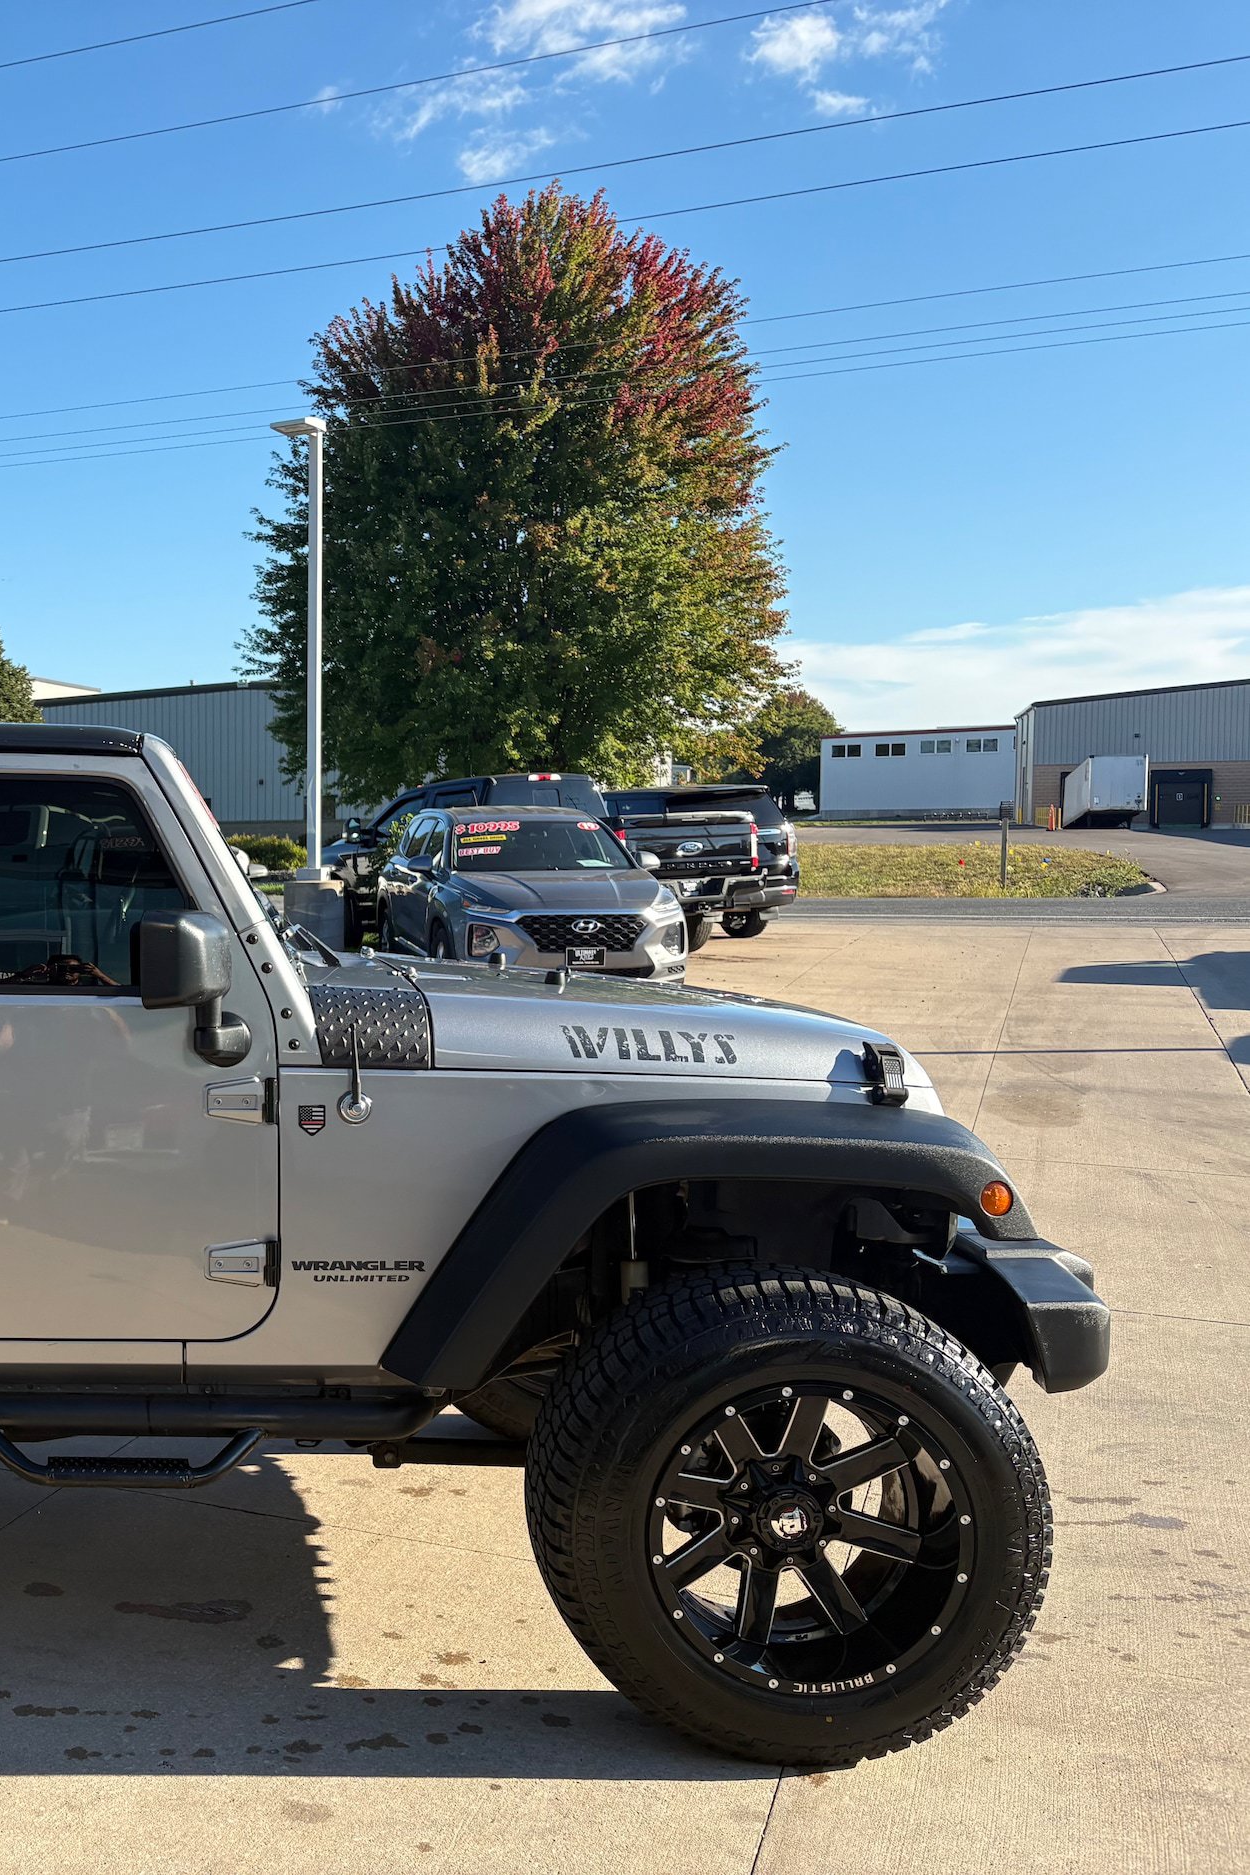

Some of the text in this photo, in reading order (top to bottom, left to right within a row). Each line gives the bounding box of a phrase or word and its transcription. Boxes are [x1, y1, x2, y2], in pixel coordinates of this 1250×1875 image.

[558, 1025, 737, 1065] WILLYS
[291, 1261, 426, 1272] WRANGLER
[792, 1672, 875, 1693] BALLISTIC
